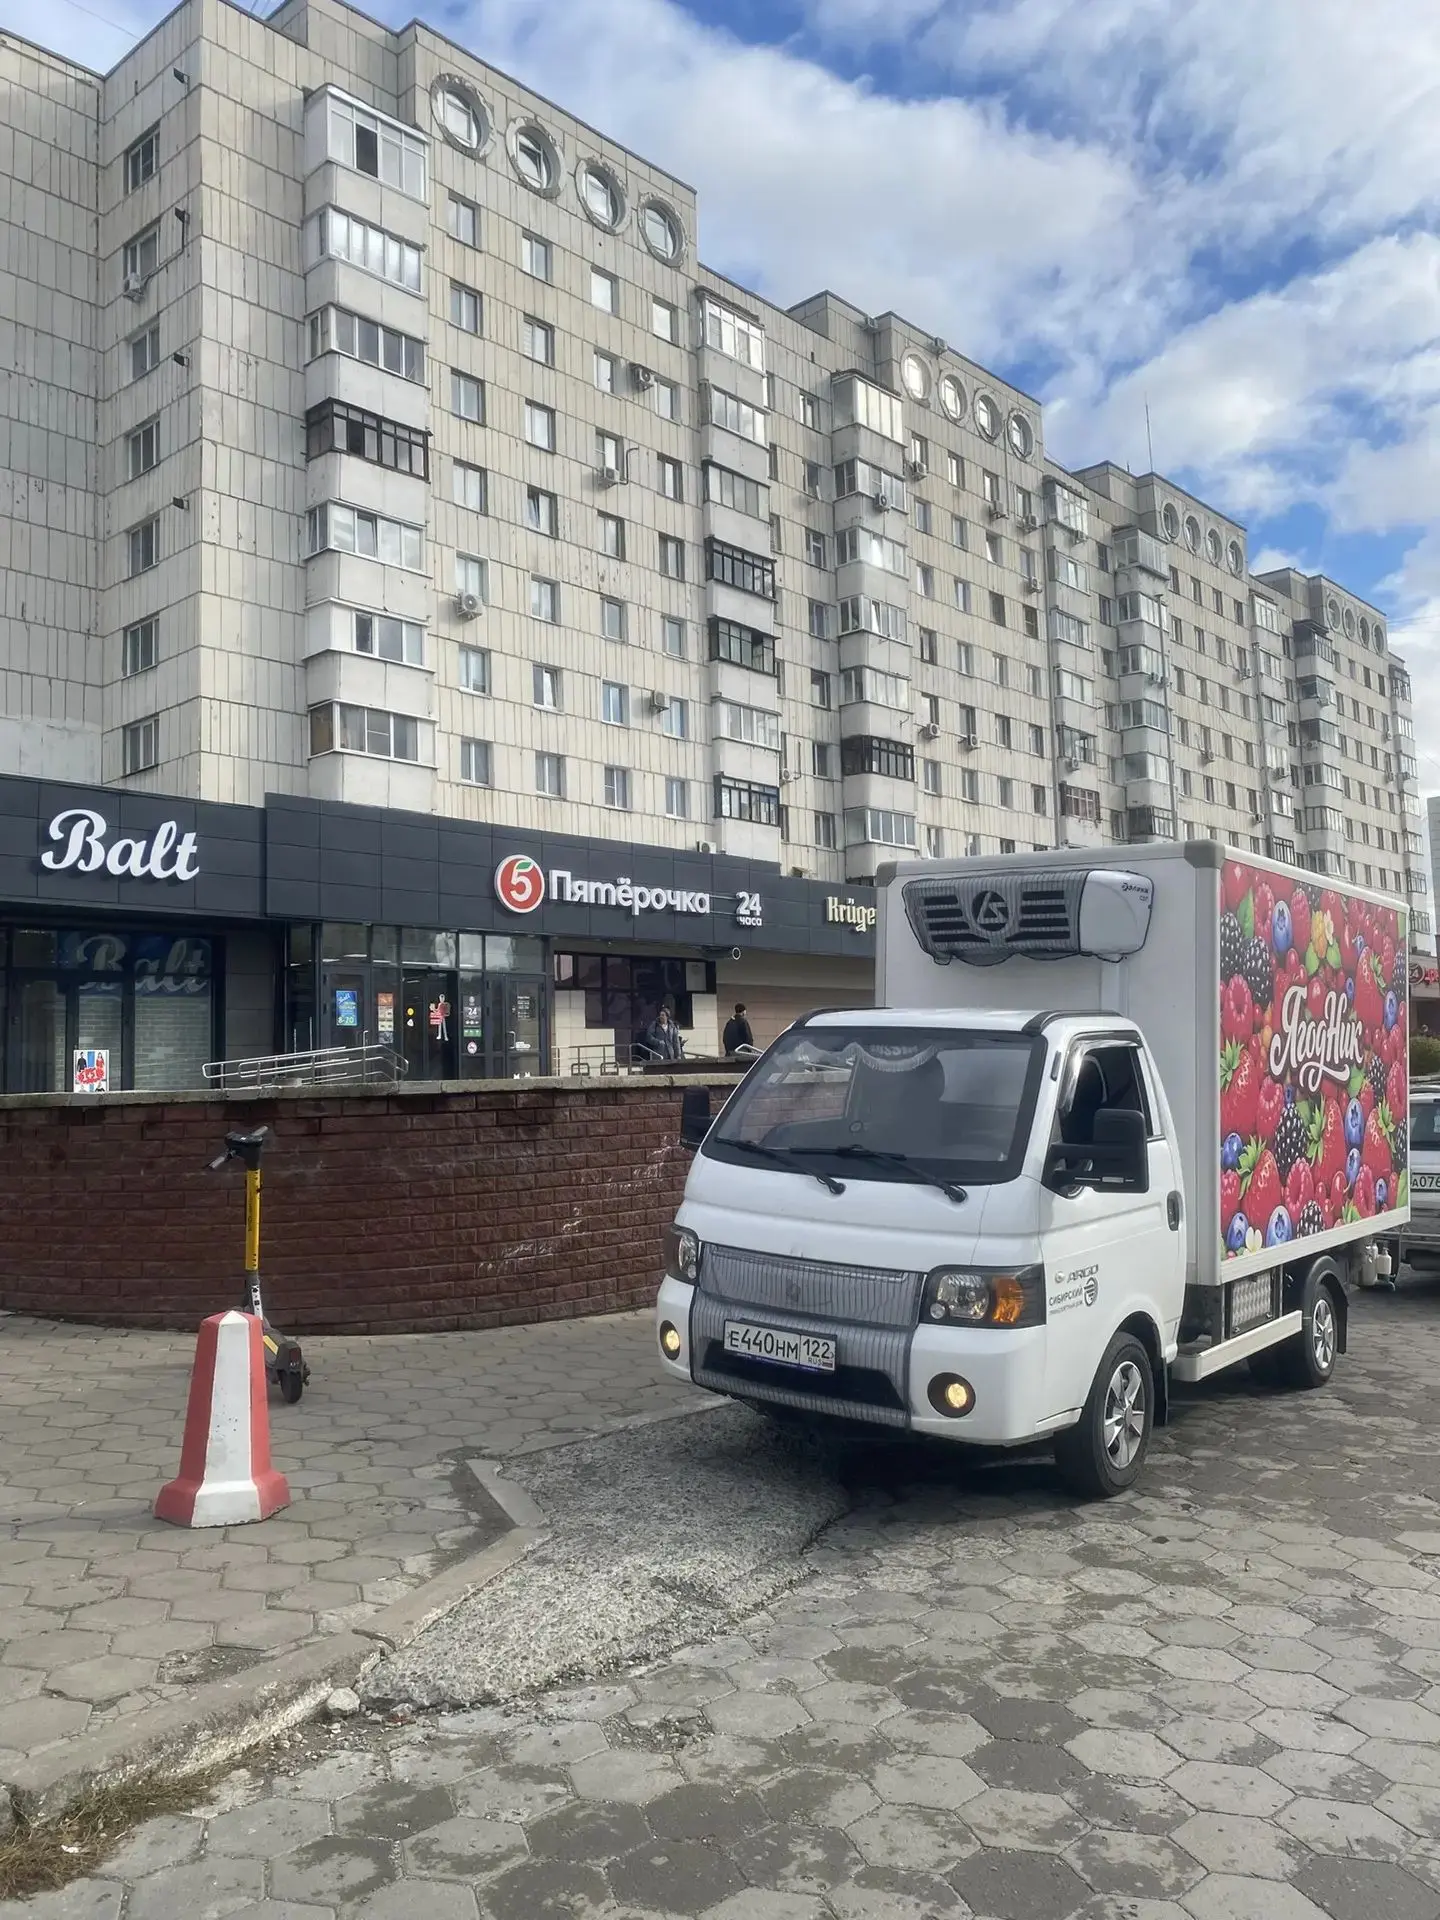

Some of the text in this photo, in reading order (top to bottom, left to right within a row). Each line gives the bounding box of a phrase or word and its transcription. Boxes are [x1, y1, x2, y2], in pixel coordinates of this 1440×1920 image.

[41, 808, 200, 881] Balt
[548, 869, 710, 916] Пятёрочка
[736, 891, 762, 916] 24
[737, 915, 763, 926] часа
[1067, 1263, 1099, 1283] ARGO
[730, 1328, 831, 1360] Е440НМ 122
[808, 1357, 823, 1367] RUS
